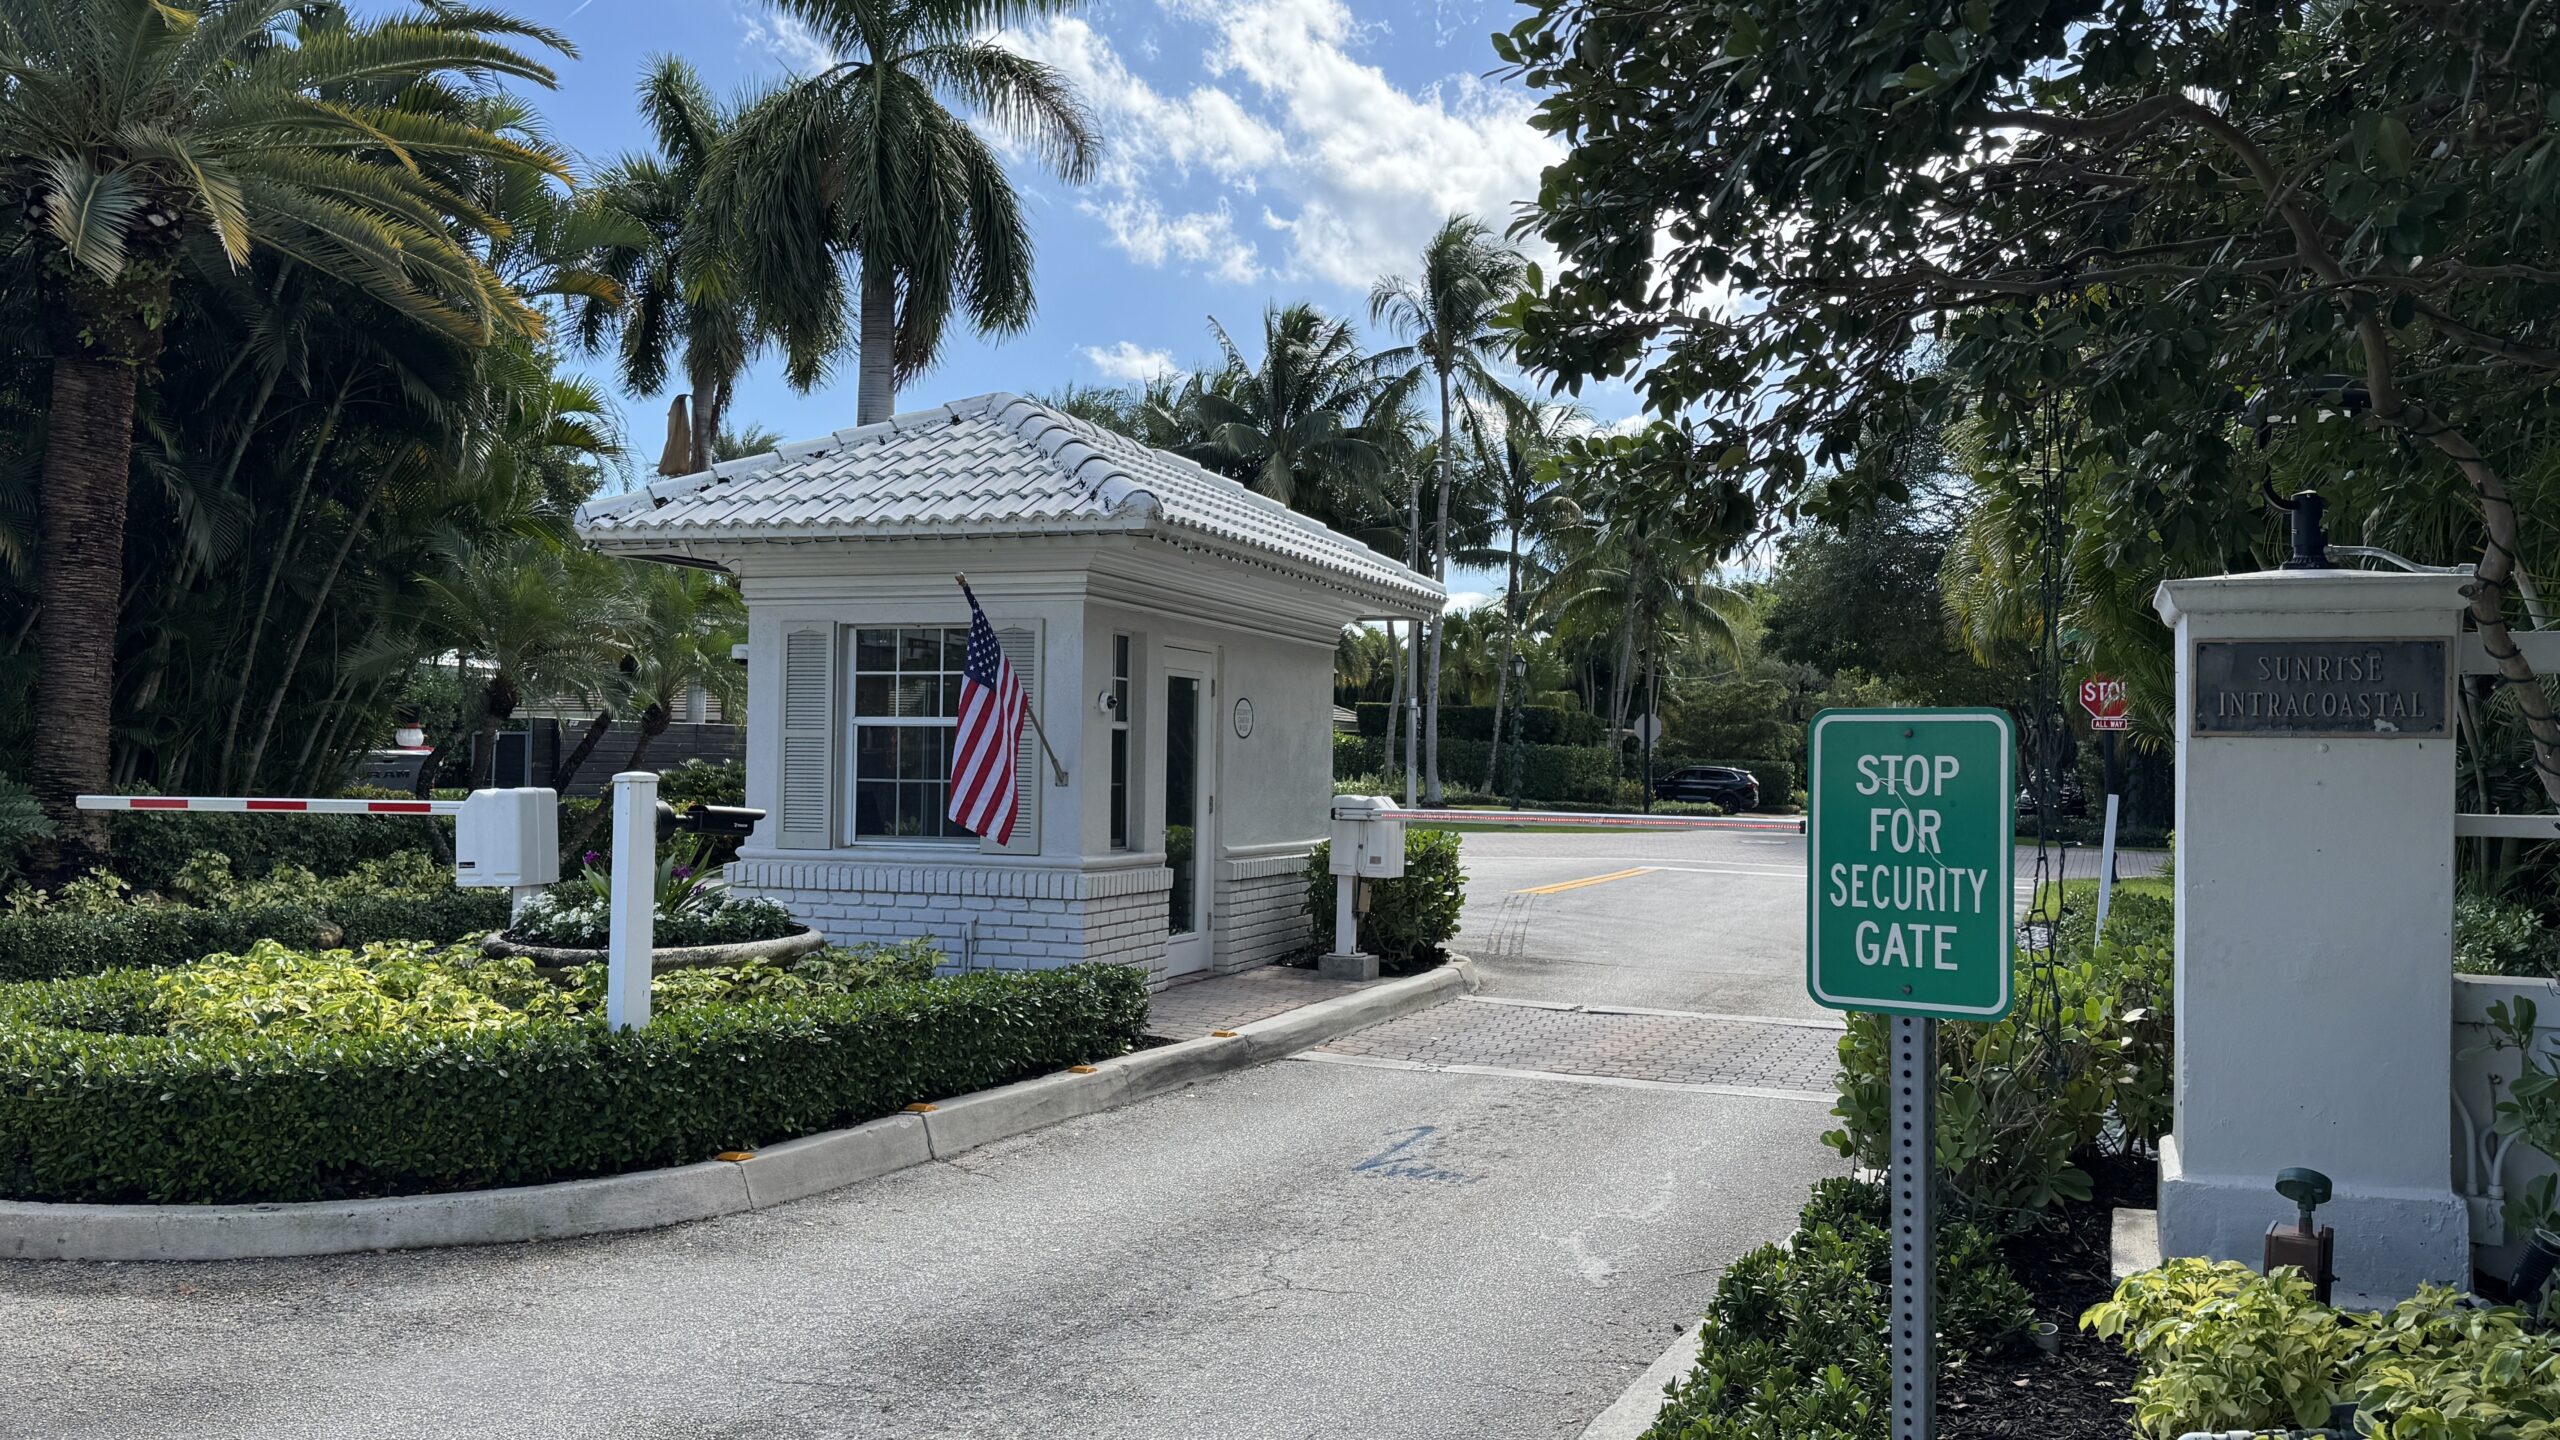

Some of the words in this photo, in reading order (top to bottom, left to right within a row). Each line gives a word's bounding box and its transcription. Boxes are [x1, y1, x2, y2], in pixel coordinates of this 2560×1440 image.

[2258, 655, 2383, 682] SUNRISE
[2095, 720, 2107, 728] ALL
[2110, 720, 2123, 728] WAY
[2217, 691, 2426, 718] INTRACOASTAL
[1856, 755, 1959, 796] STOP
[1871, 808, 1941, 853] FOR
[1830, 863, 1987, 913] SECURITY
[1856, 920, 1958, 970] GATE
